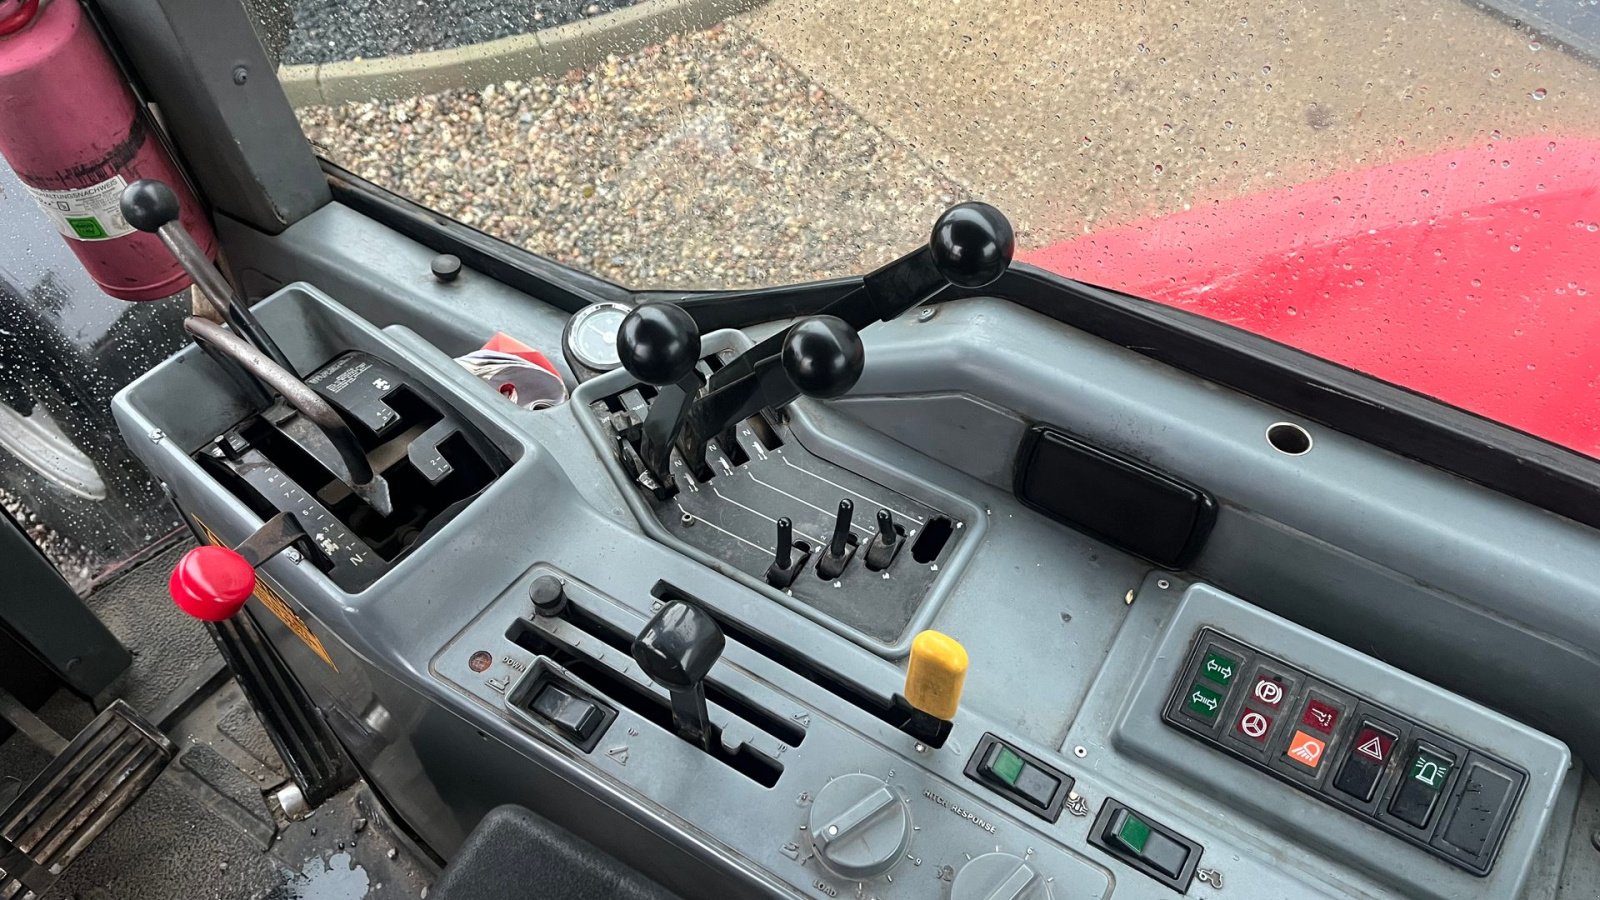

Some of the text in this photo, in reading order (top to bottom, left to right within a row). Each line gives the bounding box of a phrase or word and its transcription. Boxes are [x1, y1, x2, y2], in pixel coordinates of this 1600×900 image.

[502, 656, 526, 673] DOWN
[627, 727, 639, 738] UP
[922, 788, 997, 834] HITCH RESPONSE
[813, 879, 837, 897] LOAD
